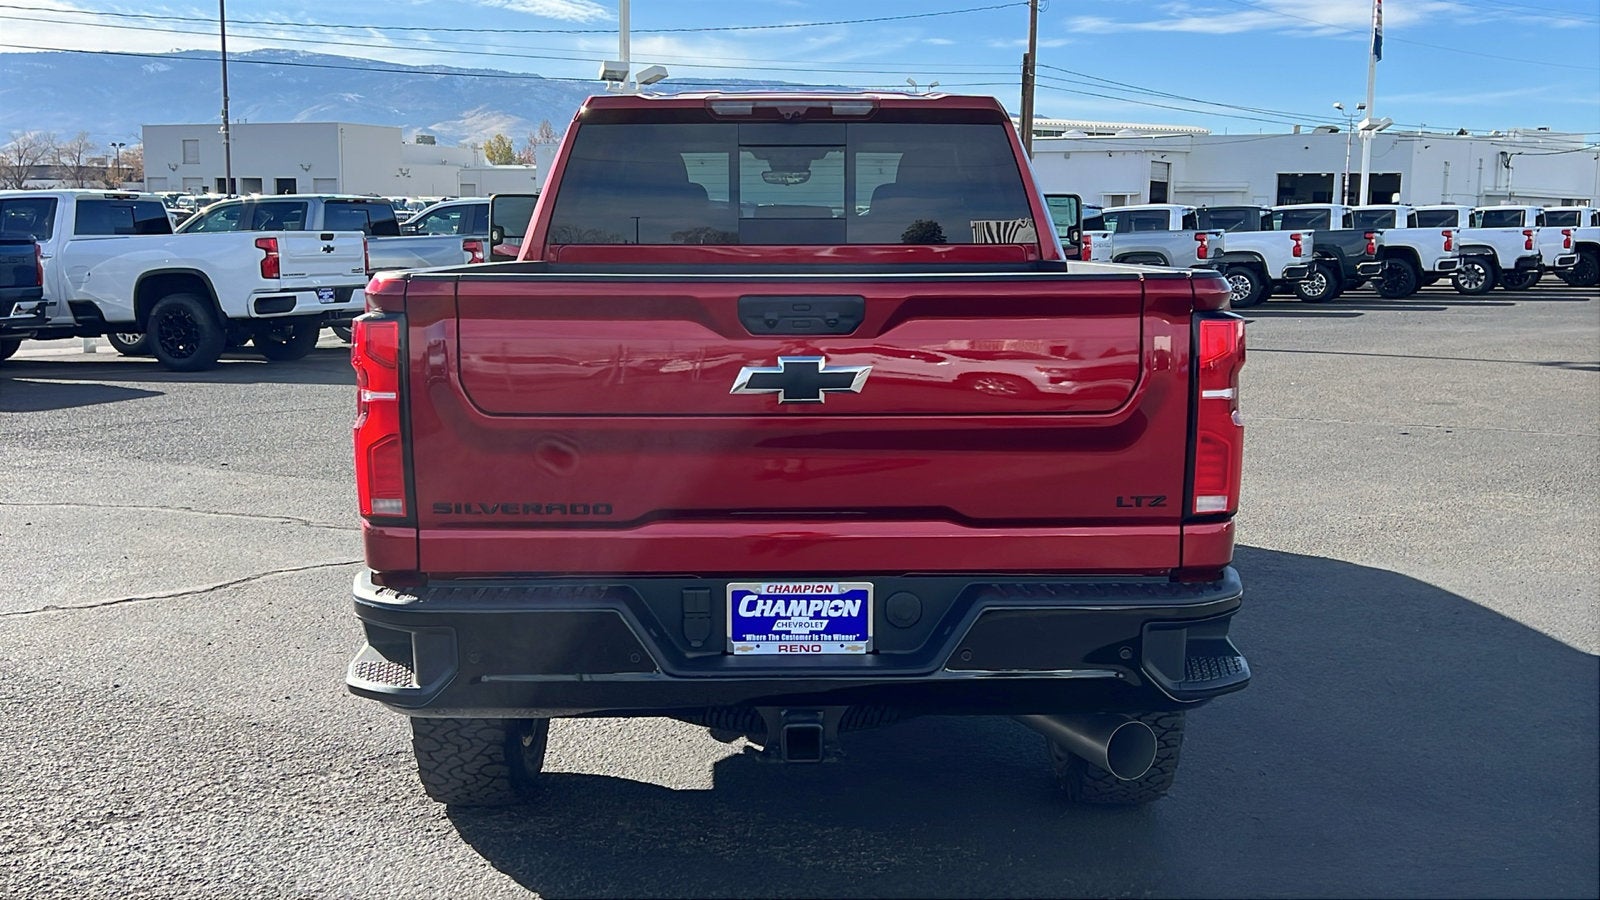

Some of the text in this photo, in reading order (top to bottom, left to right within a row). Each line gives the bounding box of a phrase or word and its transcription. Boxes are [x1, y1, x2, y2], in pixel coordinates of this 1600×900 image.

[1116, 495, 1167, 508] LTZ
[432, 502, 613, 516] SILVERADO
[766, 584, 834, 594] CHAMPION
[738, 595, 862, 618] CHAMPION
[776, 621, 824, 629] CHEVROLET
[768, 633, 780, 641] The
[781, 633, 812, 641] Customer
[812, 633, 819, 641] Is
[820, 633, 832, 641] The
[778, 644, 822, 653] RENO
